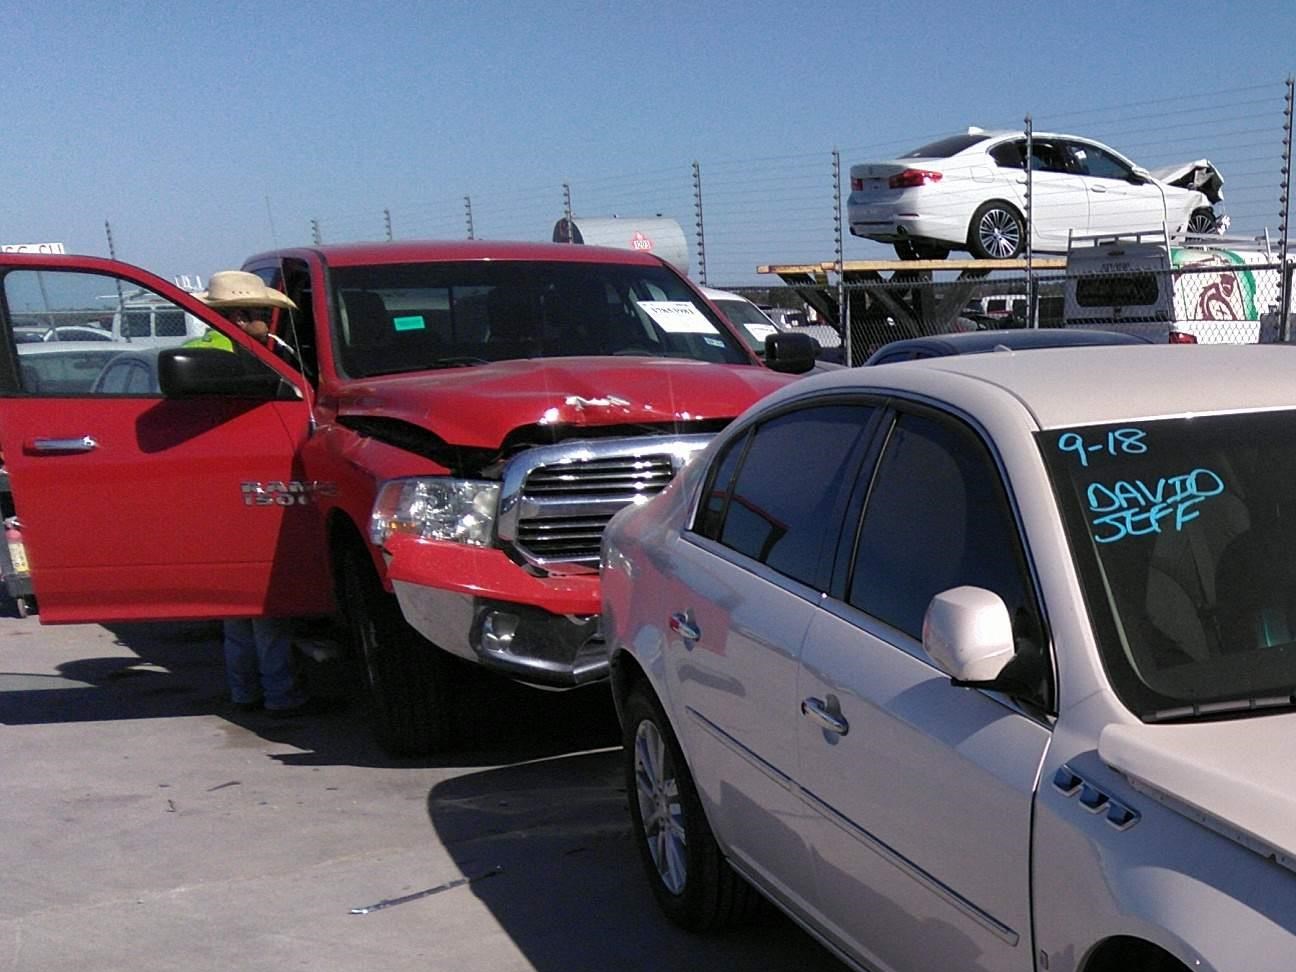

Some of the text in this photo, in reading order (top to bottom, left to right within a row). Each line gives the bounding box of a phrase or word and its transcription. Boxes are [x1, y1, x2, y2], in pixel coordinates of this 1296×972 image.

[1058, 428, 1148, 467] 9-18
[1087, 468, 1225, 512] DAVID
[1092, 496, 1206, 543] JEFF
